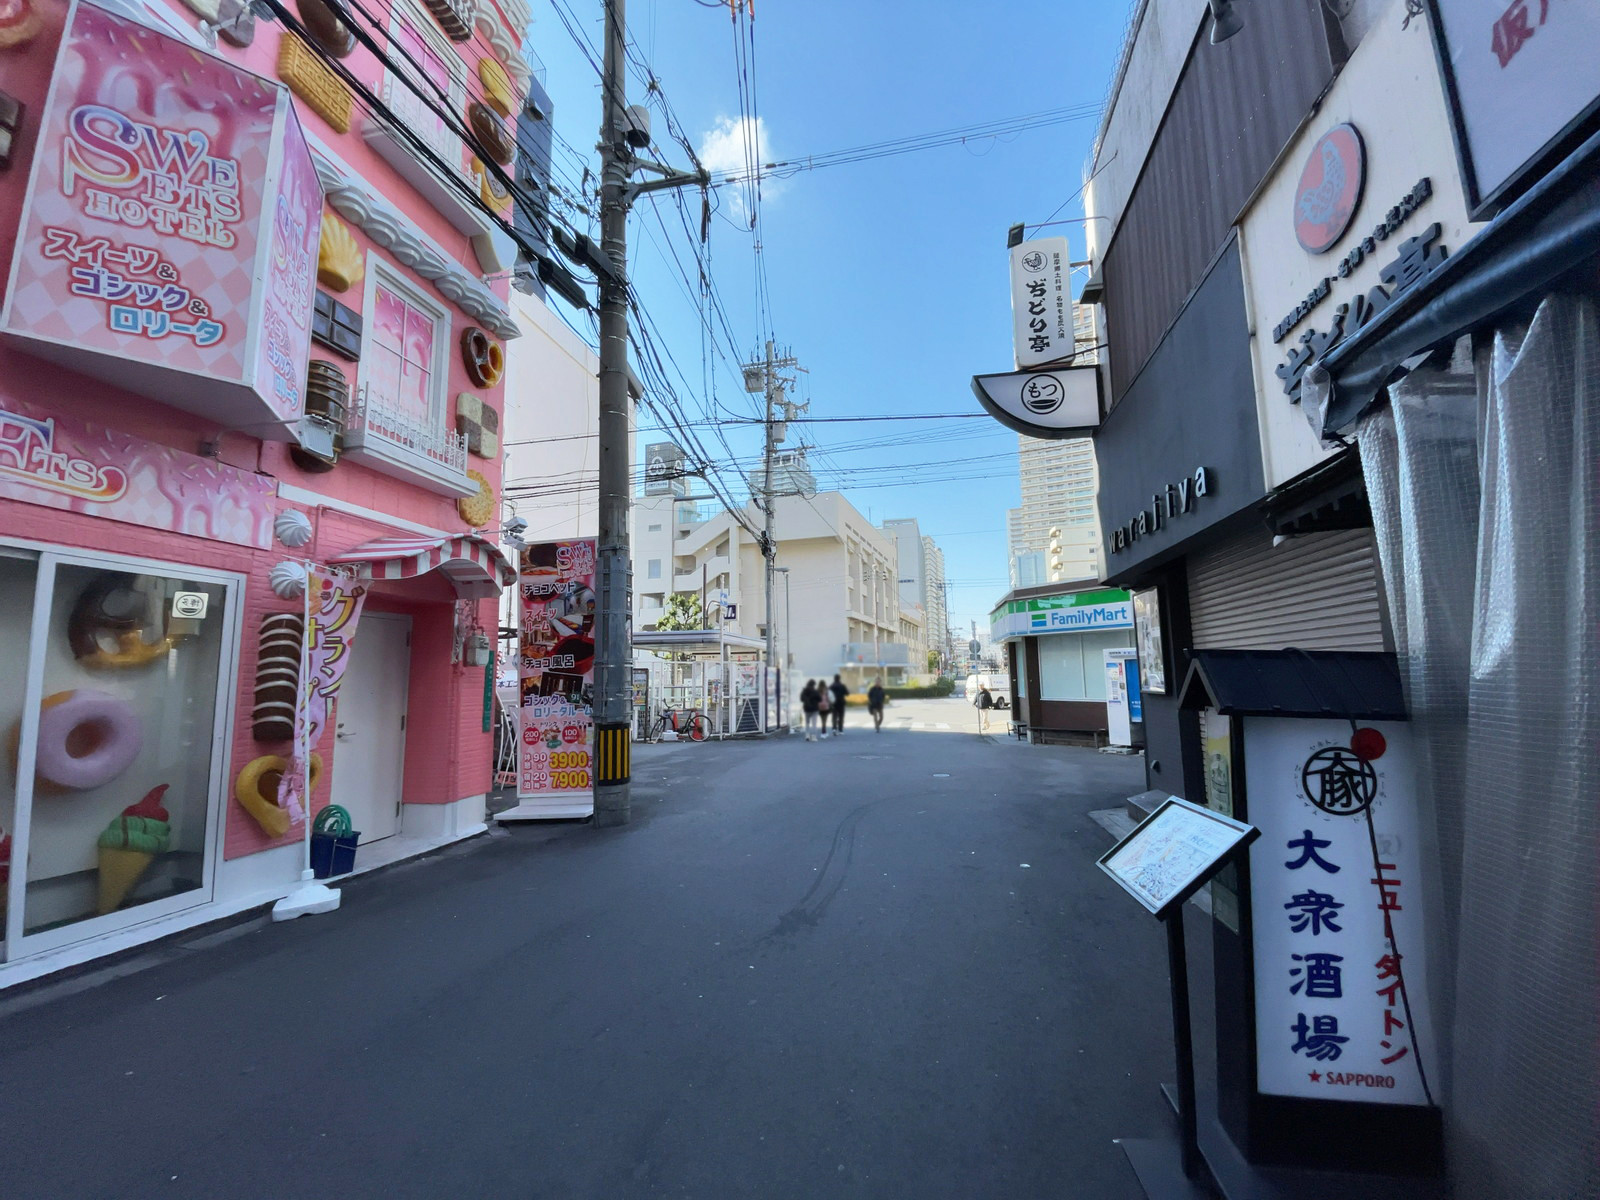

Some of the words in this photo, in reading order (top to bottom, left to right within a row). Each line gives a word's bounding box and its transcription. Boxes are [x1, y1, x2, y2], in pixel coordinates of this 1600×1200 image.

[84, 188, 236, 248] HOTEL
[110, 304, 224, 346] ロリータ
[1028, 382, 1058, 399] もつ
[1108, 467, 1207, 554] warajiya
[524, 581, 575, 595] チョコベッド
[525, 608, 557, 622] スイーツ
[1051, 606, 1128, 626] FamilyMart
[525, 620, 550, 632] ルーム
[525, 654, 574, 669] チョコ風呂
[534, 705, 592, 718] ロリータルーム
[549, 751, 588, 769] 3900
[550, 770, 589, 789] 7900
[1284, 829, 1350, 1062] 大衆酒場
[1326, 1071, 1395, 1089] SAPPORO
